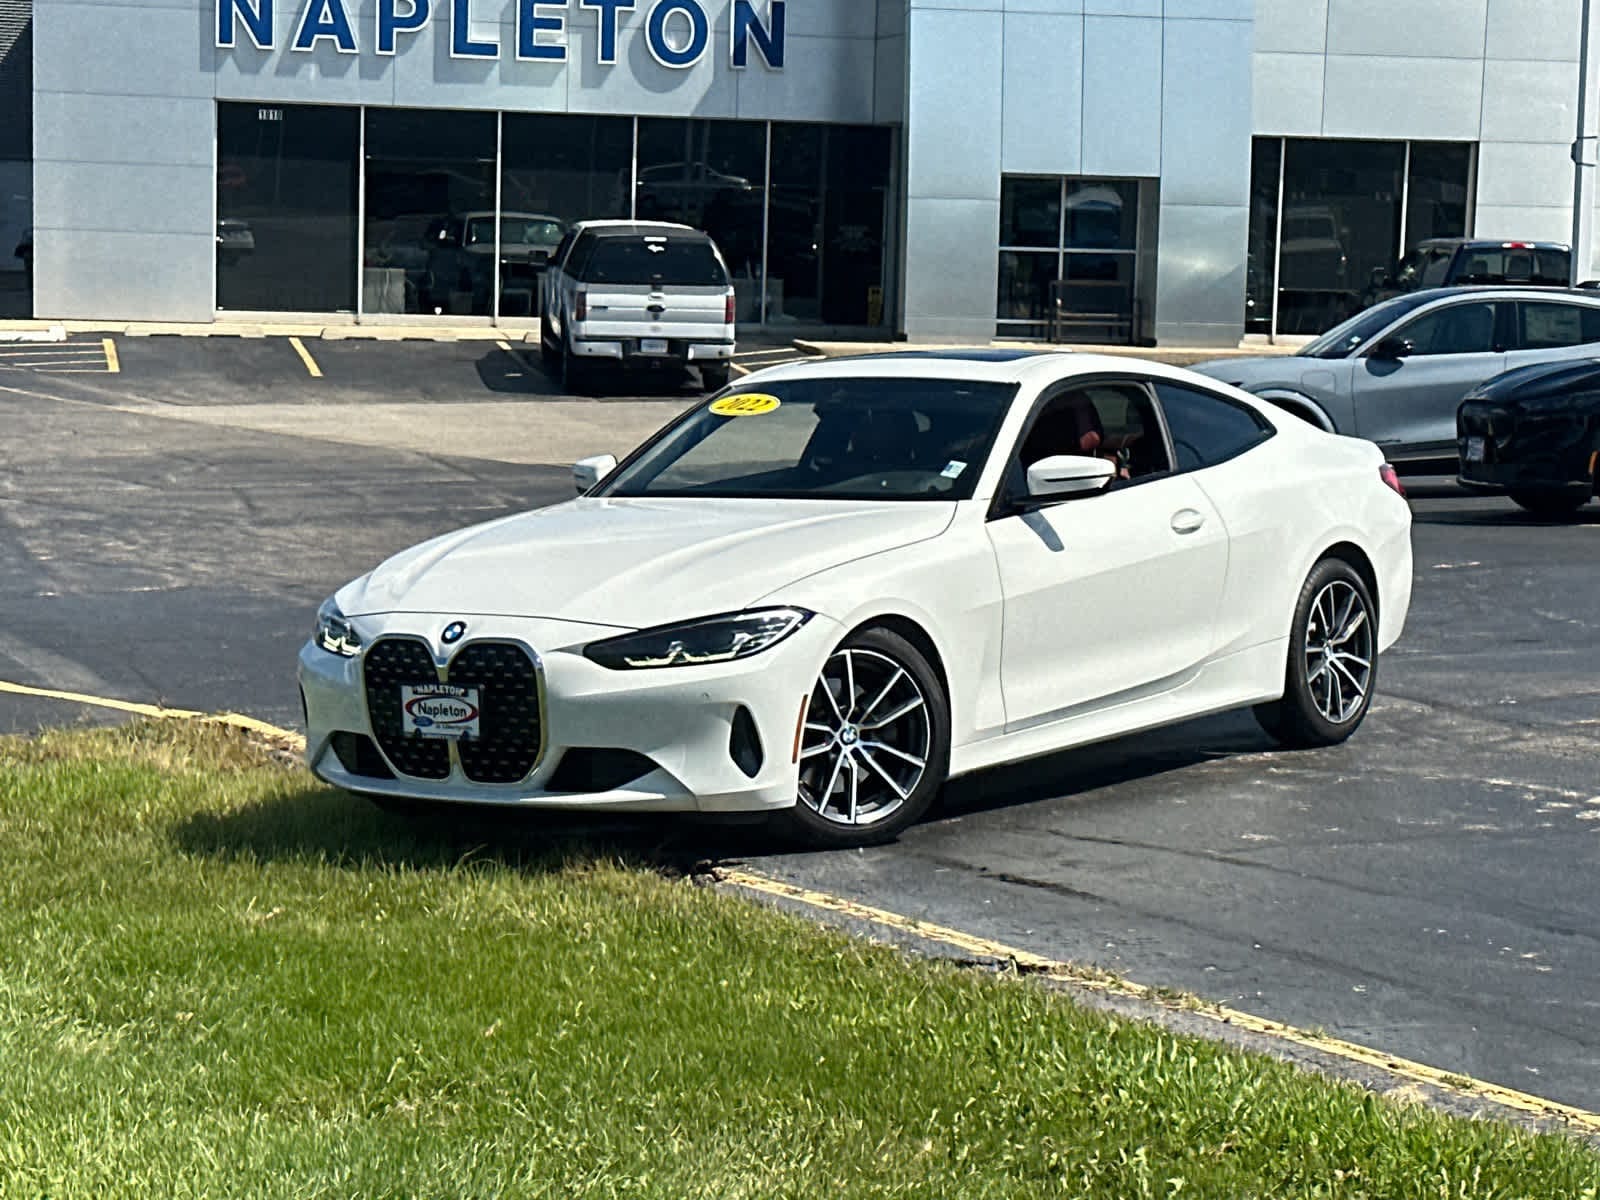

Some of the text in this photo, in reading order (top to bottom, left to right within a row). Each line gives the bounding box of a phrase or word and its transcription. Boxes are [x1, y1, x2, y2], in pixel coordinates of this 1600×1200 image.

[214, 0, 786, 70] NAPLETON
[715, 397, 772, 411] 2022
[415, 684, 466, 697] NAPLETON
[417, 702, 468, 718] Napleton
